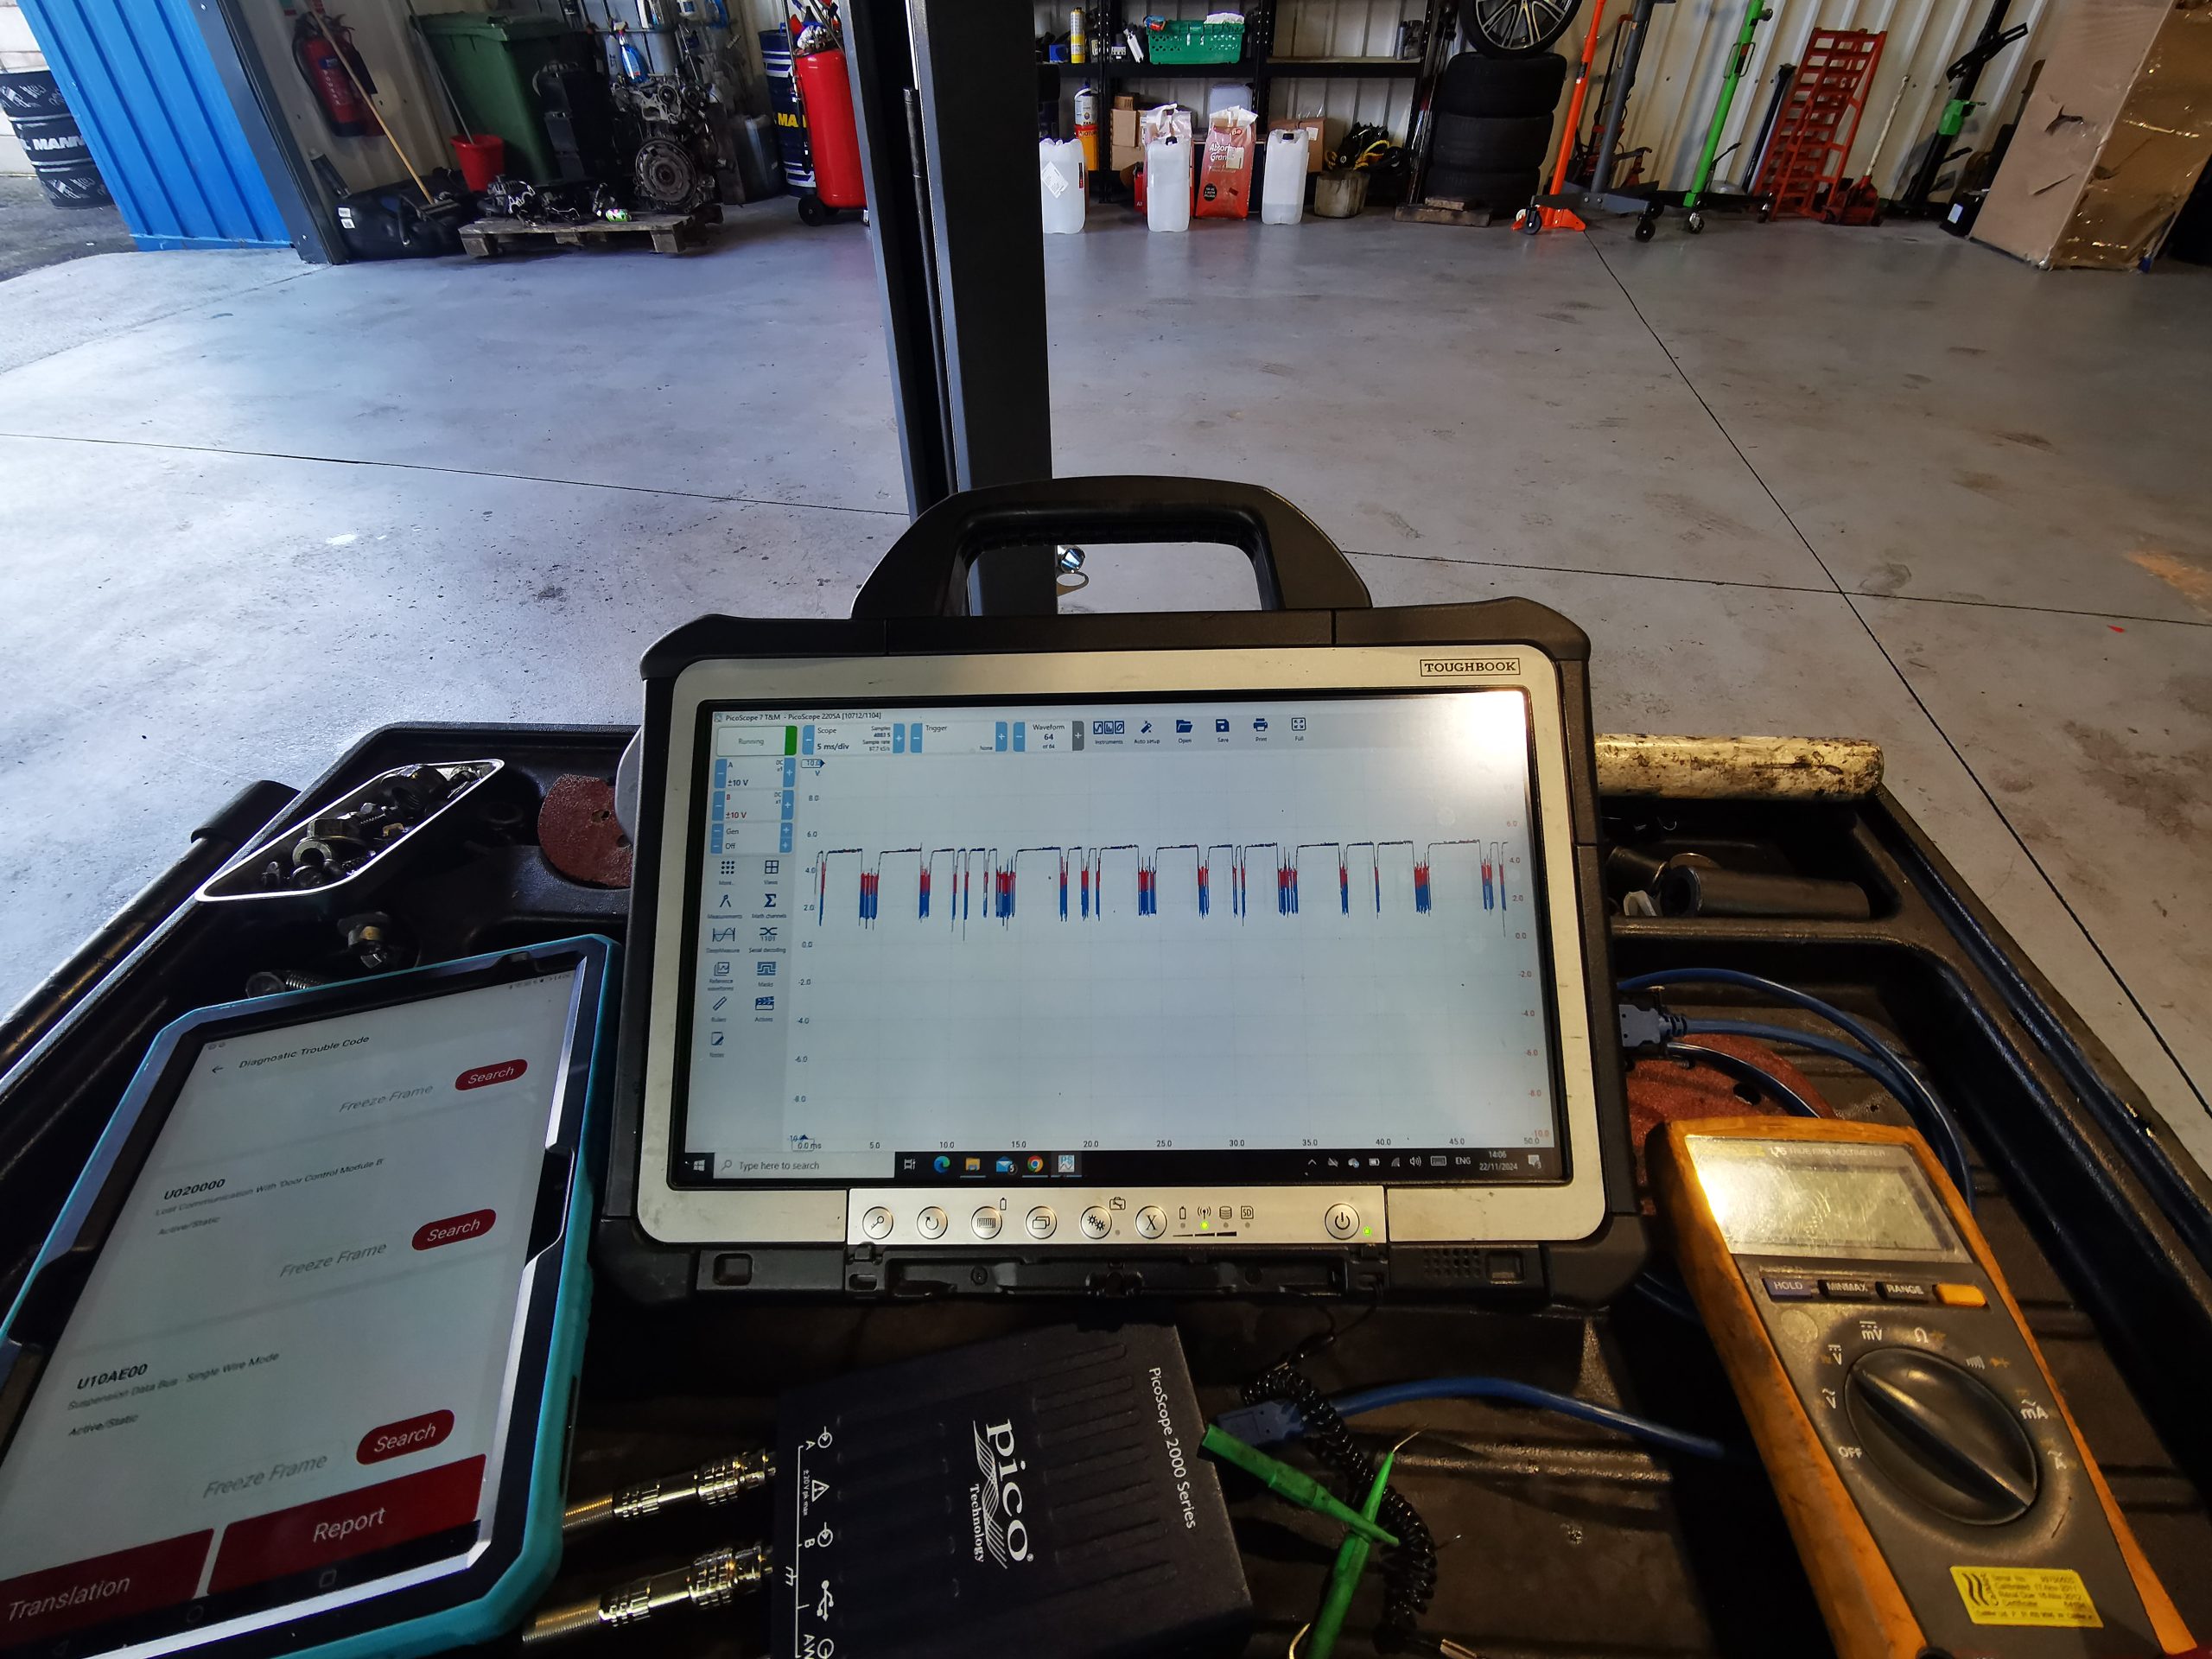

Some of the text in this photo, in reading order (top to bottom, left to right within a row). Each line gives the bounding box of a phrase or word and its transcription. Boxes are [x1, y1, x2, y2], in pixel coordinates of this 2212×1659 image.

[1424, 661, 1516, 672] TOUGHBOOK
[788, 713, 820, 721] PicoScope
[238, 1036, 370, 1069] Diagnostic Trouble Code
[467, 1065, 515, 1085] Search
[339, 1084, 434, 1113] Freeze Frame
[1083, 1140, 1099, 1148] 20.0
[740, 1160, 820, 1171] Type here to search
[1455, 1156, 1471, 1165] ENG
[304, 1168, 339, 1183] Control
[340, 1160, 374, 1174] Module
[163, 1178, 226, 1200] U020000
[1243, 1208, 1252, 1217] SD
[426, 1218, 480, 1243] Search
[279, 1243, 387, 1279] Freeze Frame
[1773, 1281, 1804, 1291] HOLD
[1885, 1284, 1925, 1295] RANGE
[1861, 1328, 1883, 1341] mV
[248, 1353, 280, 1367] Mode
[2019, 1405, 2050, 1420] mA
[373, 1422, 436, 1453] Search
[804, 1440, 816, 1451] A
[1148, 1367, 1196, 1529] PicoScope 2000 Series
[1838, 1446, 1863, 1459] OFF
[202, 1455, 328, 1499] Freeze Frame
[312, 1506, 387, 1544] Report
[969, 1483, 986, 1563] Technology
[804, 1537, 816, 1548] B
[8, 1577, 130, 1622] Translation
